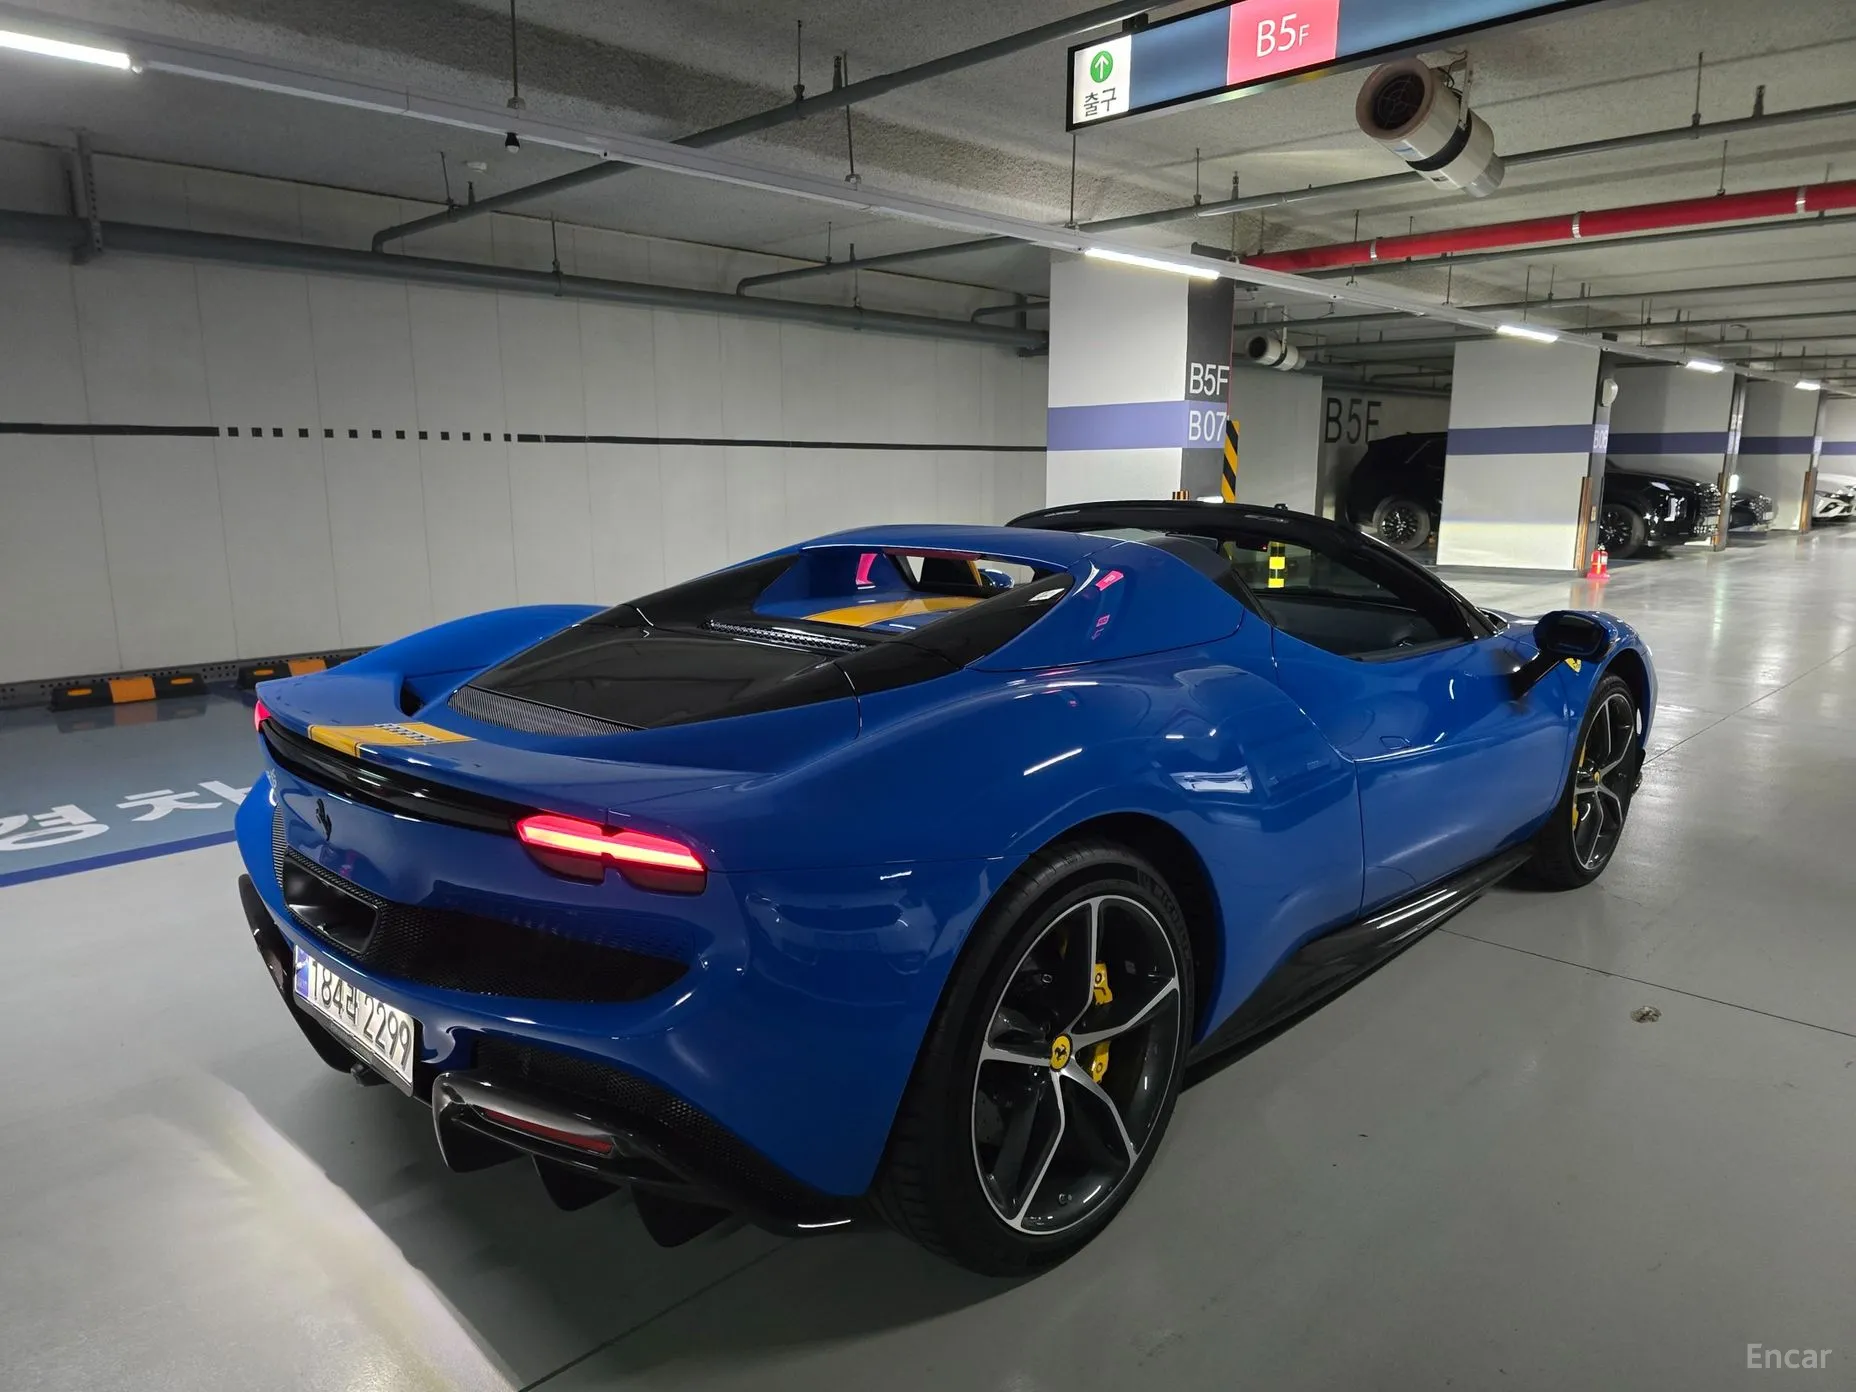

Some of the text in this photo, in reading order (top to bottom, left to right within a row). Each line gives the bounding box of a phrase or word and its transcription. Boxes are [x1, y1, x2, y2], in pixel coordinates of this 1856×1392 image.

[1256, 13, 1310, 58] B5F
[1084, 87, 1117, 118] 출구
[1189, 362, 1230, 396] B5F
[1188, 409, 1228, 442] B07
[1323, 397, 1382, 445] B5F
[363, 997, 413, 1072] 2299
